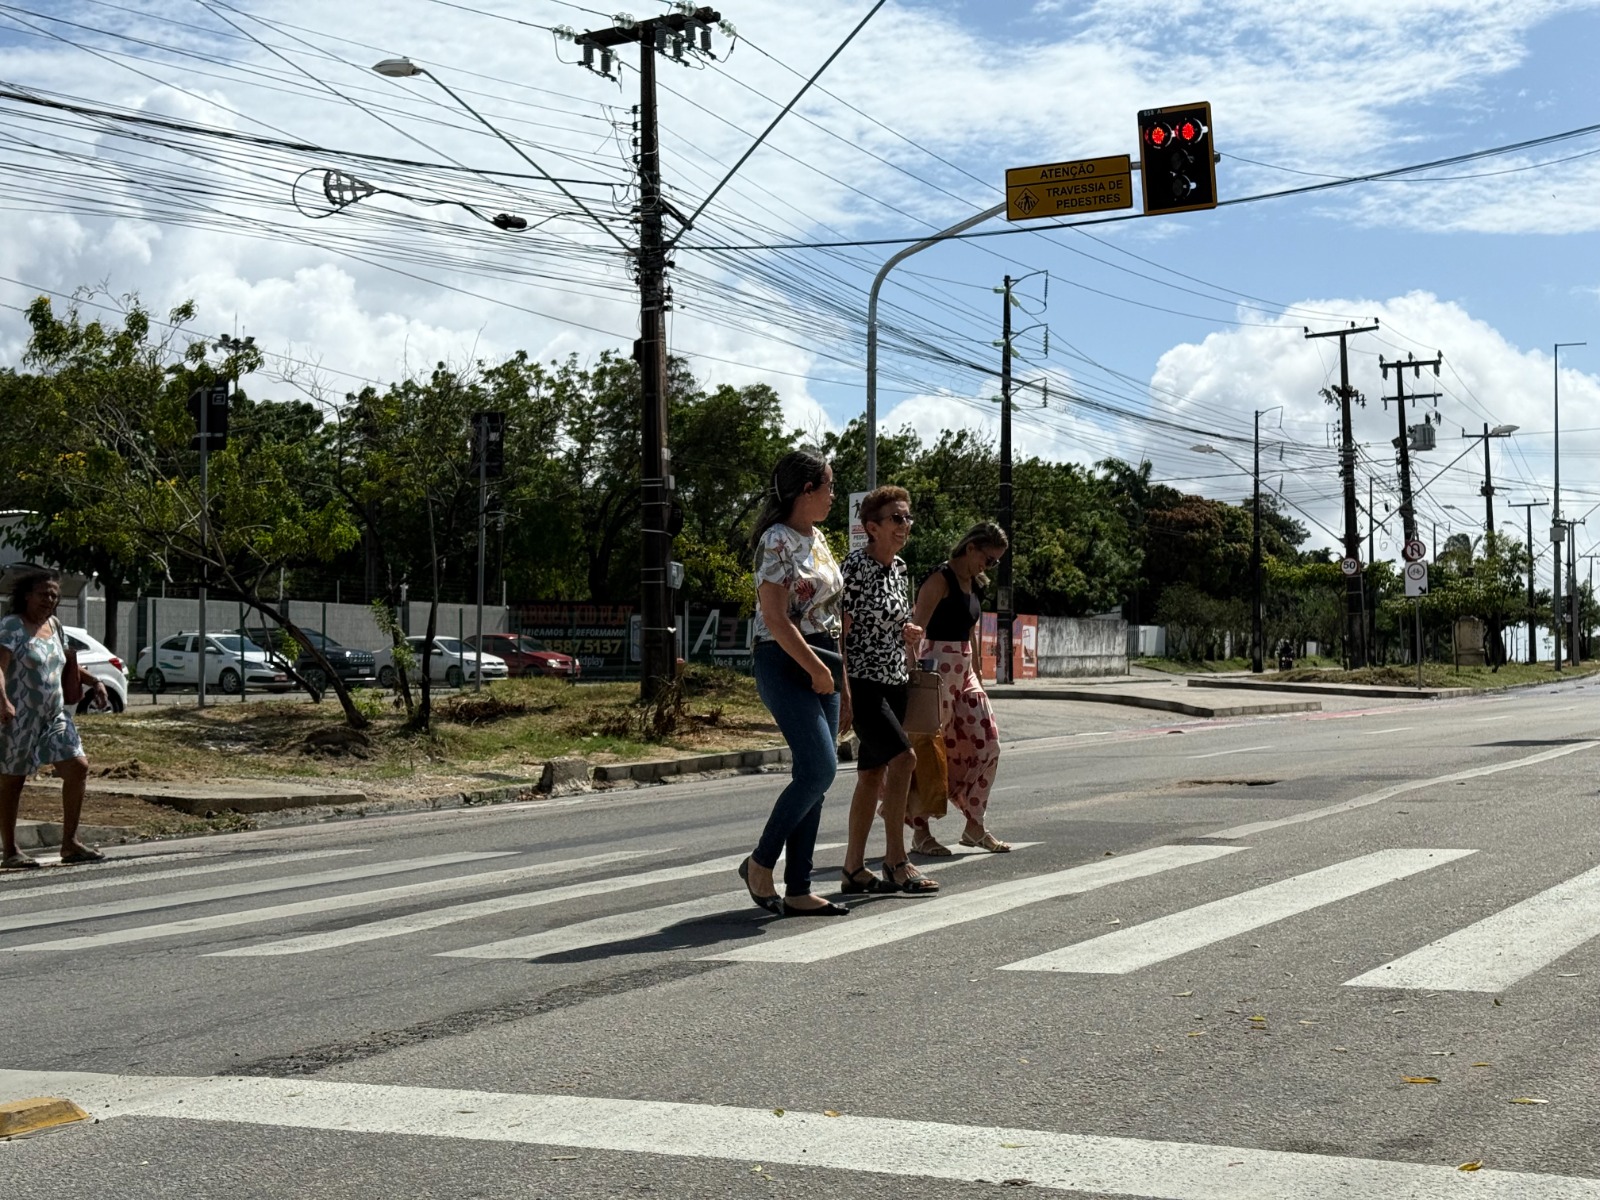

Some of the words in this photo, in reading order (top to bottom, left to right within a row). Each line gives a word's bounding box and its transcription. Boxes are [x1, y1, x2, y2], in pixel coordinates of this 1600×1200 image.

[1040, 164, 1095, 180] ATENÇÃO
[1046, 182, 1105, 198] TRAVESSIA
[1108, 179, 1124, 190] DE
[1056, 193, 1121, 209] PEDESTRES
[1343, 561, 1355, 570] 50
[574, 604, 596, 625] KID
[598, 604, 635, 625] PLAY
[578, 655, 605, 668] idplay
[714, 657, 733, 666] Você
